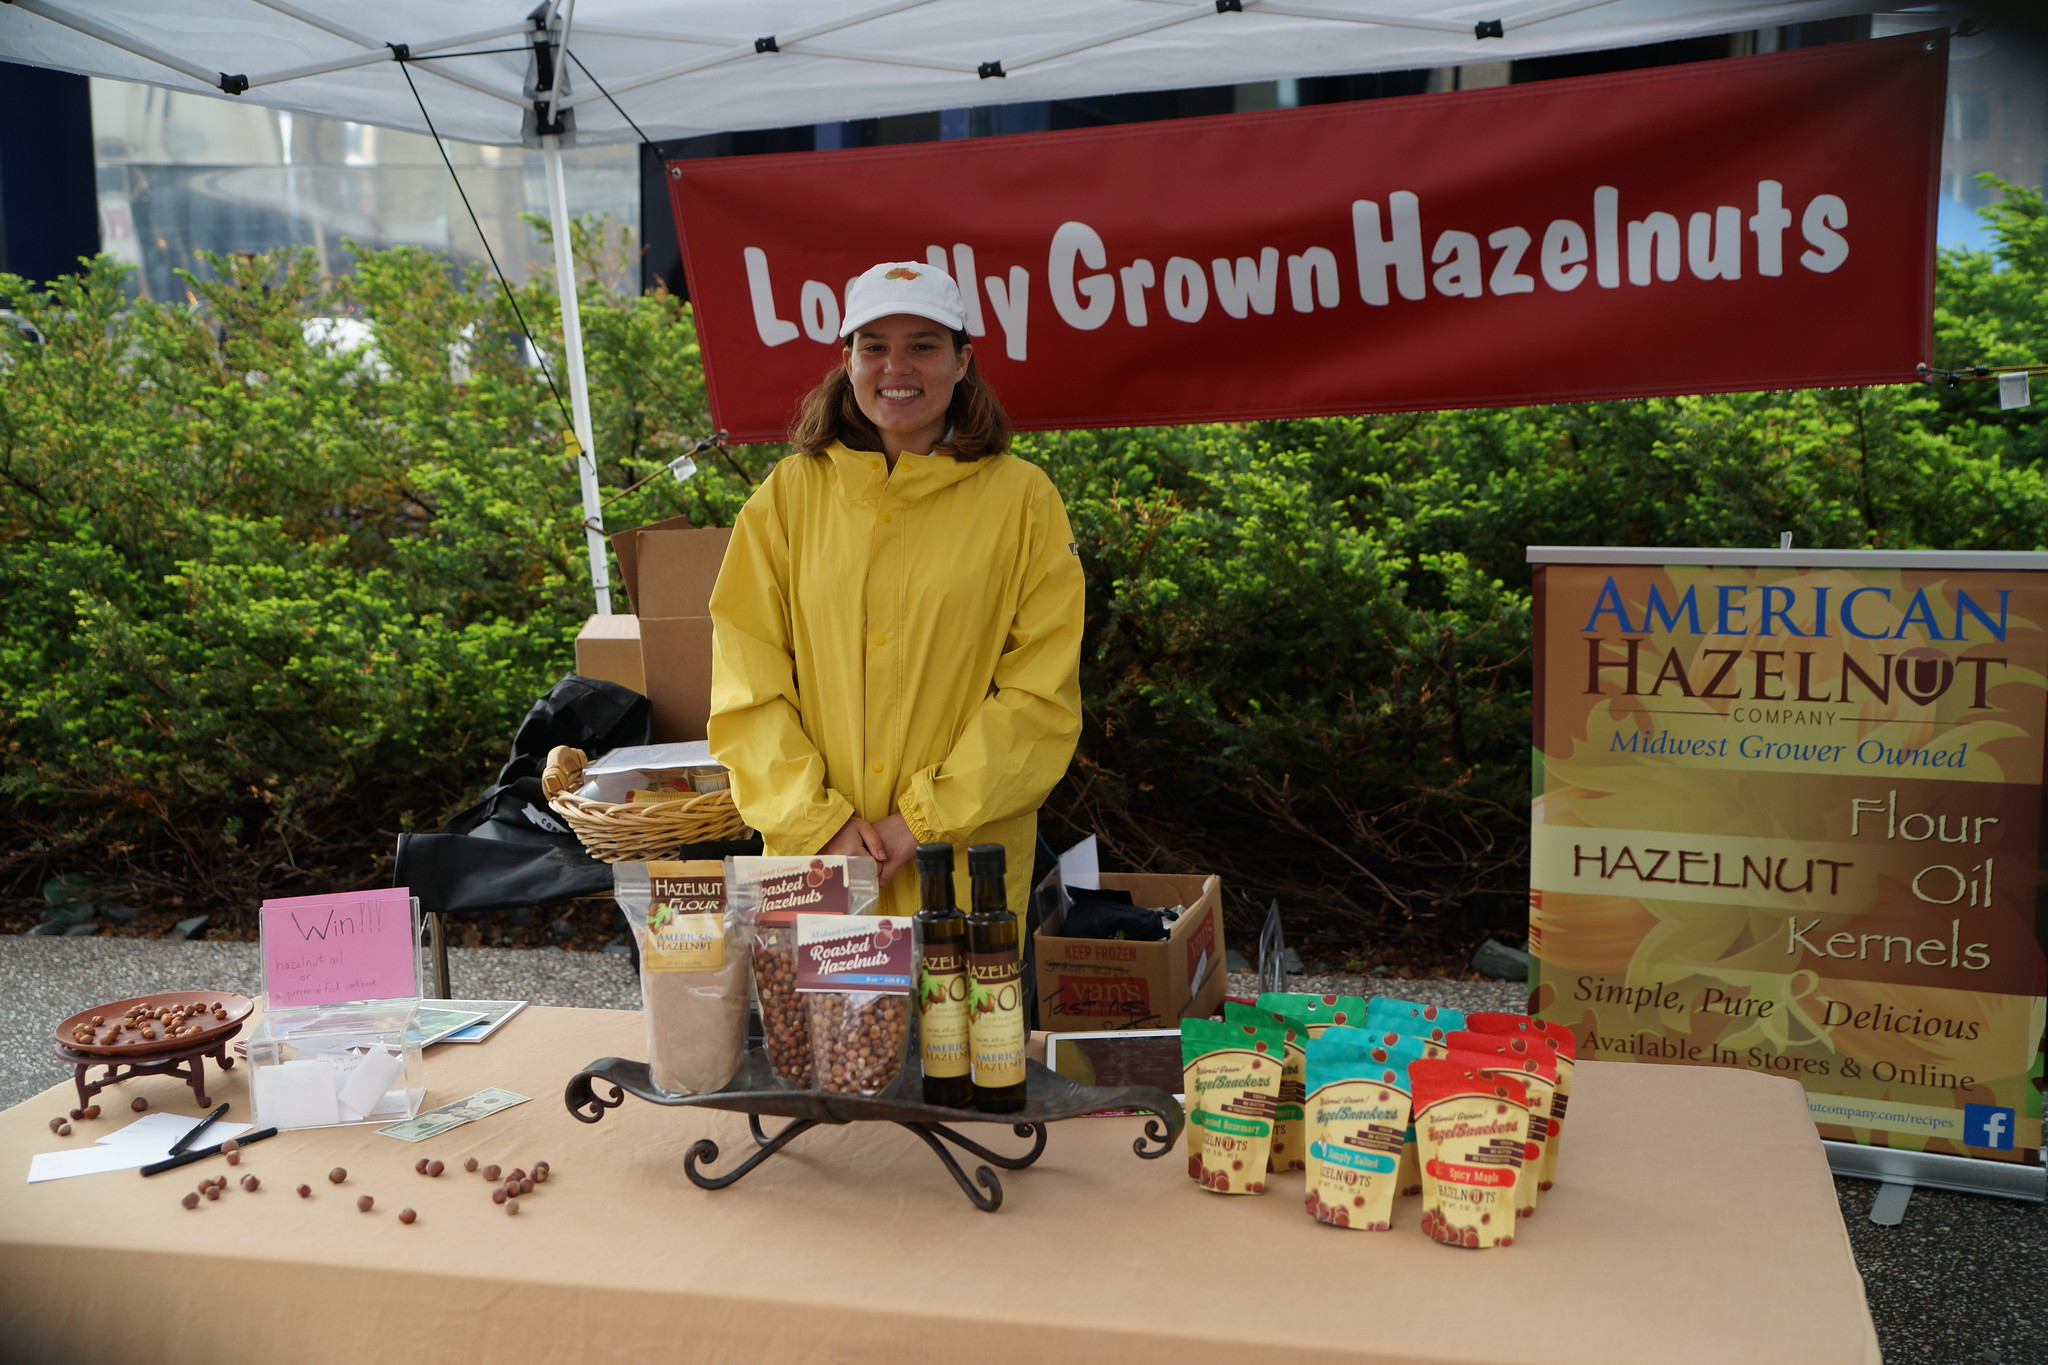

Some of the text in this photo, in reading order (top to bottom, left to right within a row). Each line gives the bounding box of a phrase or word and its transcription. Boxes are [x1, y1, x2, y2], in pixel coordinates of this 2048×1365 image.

[744, 179, 1849, 361] Loly Grown Hazelnuts
[1579, 575, 2014, 642] AMERICAN
[1582, 637, 2008, 709] HAZELNUT
[1733, 707, 1836, 727] COMPANY
[1609, 730, 1967, 769] Midwest Grower Owned
[1850, 789, 1999, 845] Flour
[1573, 844, 1854, 896] HAZELNUT
[1911, 857, 1993, 908] Oil
[655, 879, 723, 897] HAZELNUT
[760, 875, 804, 896] oasted
[668, 897, 720, 911] FLOUR
[291, 900, 382, 941] Win!!!
[657, 932, 713, 942] AMERICAN
[657, 941, 713, 951] HAZELNUT
[809, 936, 871, 961] Roasted
[1786, 916, 1991, 971] Kernels
[275, 950, 343, 970] hazelnut oil
[817, 950, 891, 975] Hazelnuts
[1065, 944, 1137, 962] KEEP FROZEN
[300, 974, 311, 982] or
[324, 982, 339, 994] food
[345, 979, 377, 991] cookbook
[1070, 981, 1140, 1001] van's
[1574, 975, 1685, 1015] Simple,
[1701, 986, 1774, 1019] Pure
[1822, 1000, 1980, 1042] Delicious
[1582, 1030, 1976, 1092] Available In Stores & Online
[1449, 1168, 1500, 1185] Spicy Maple
